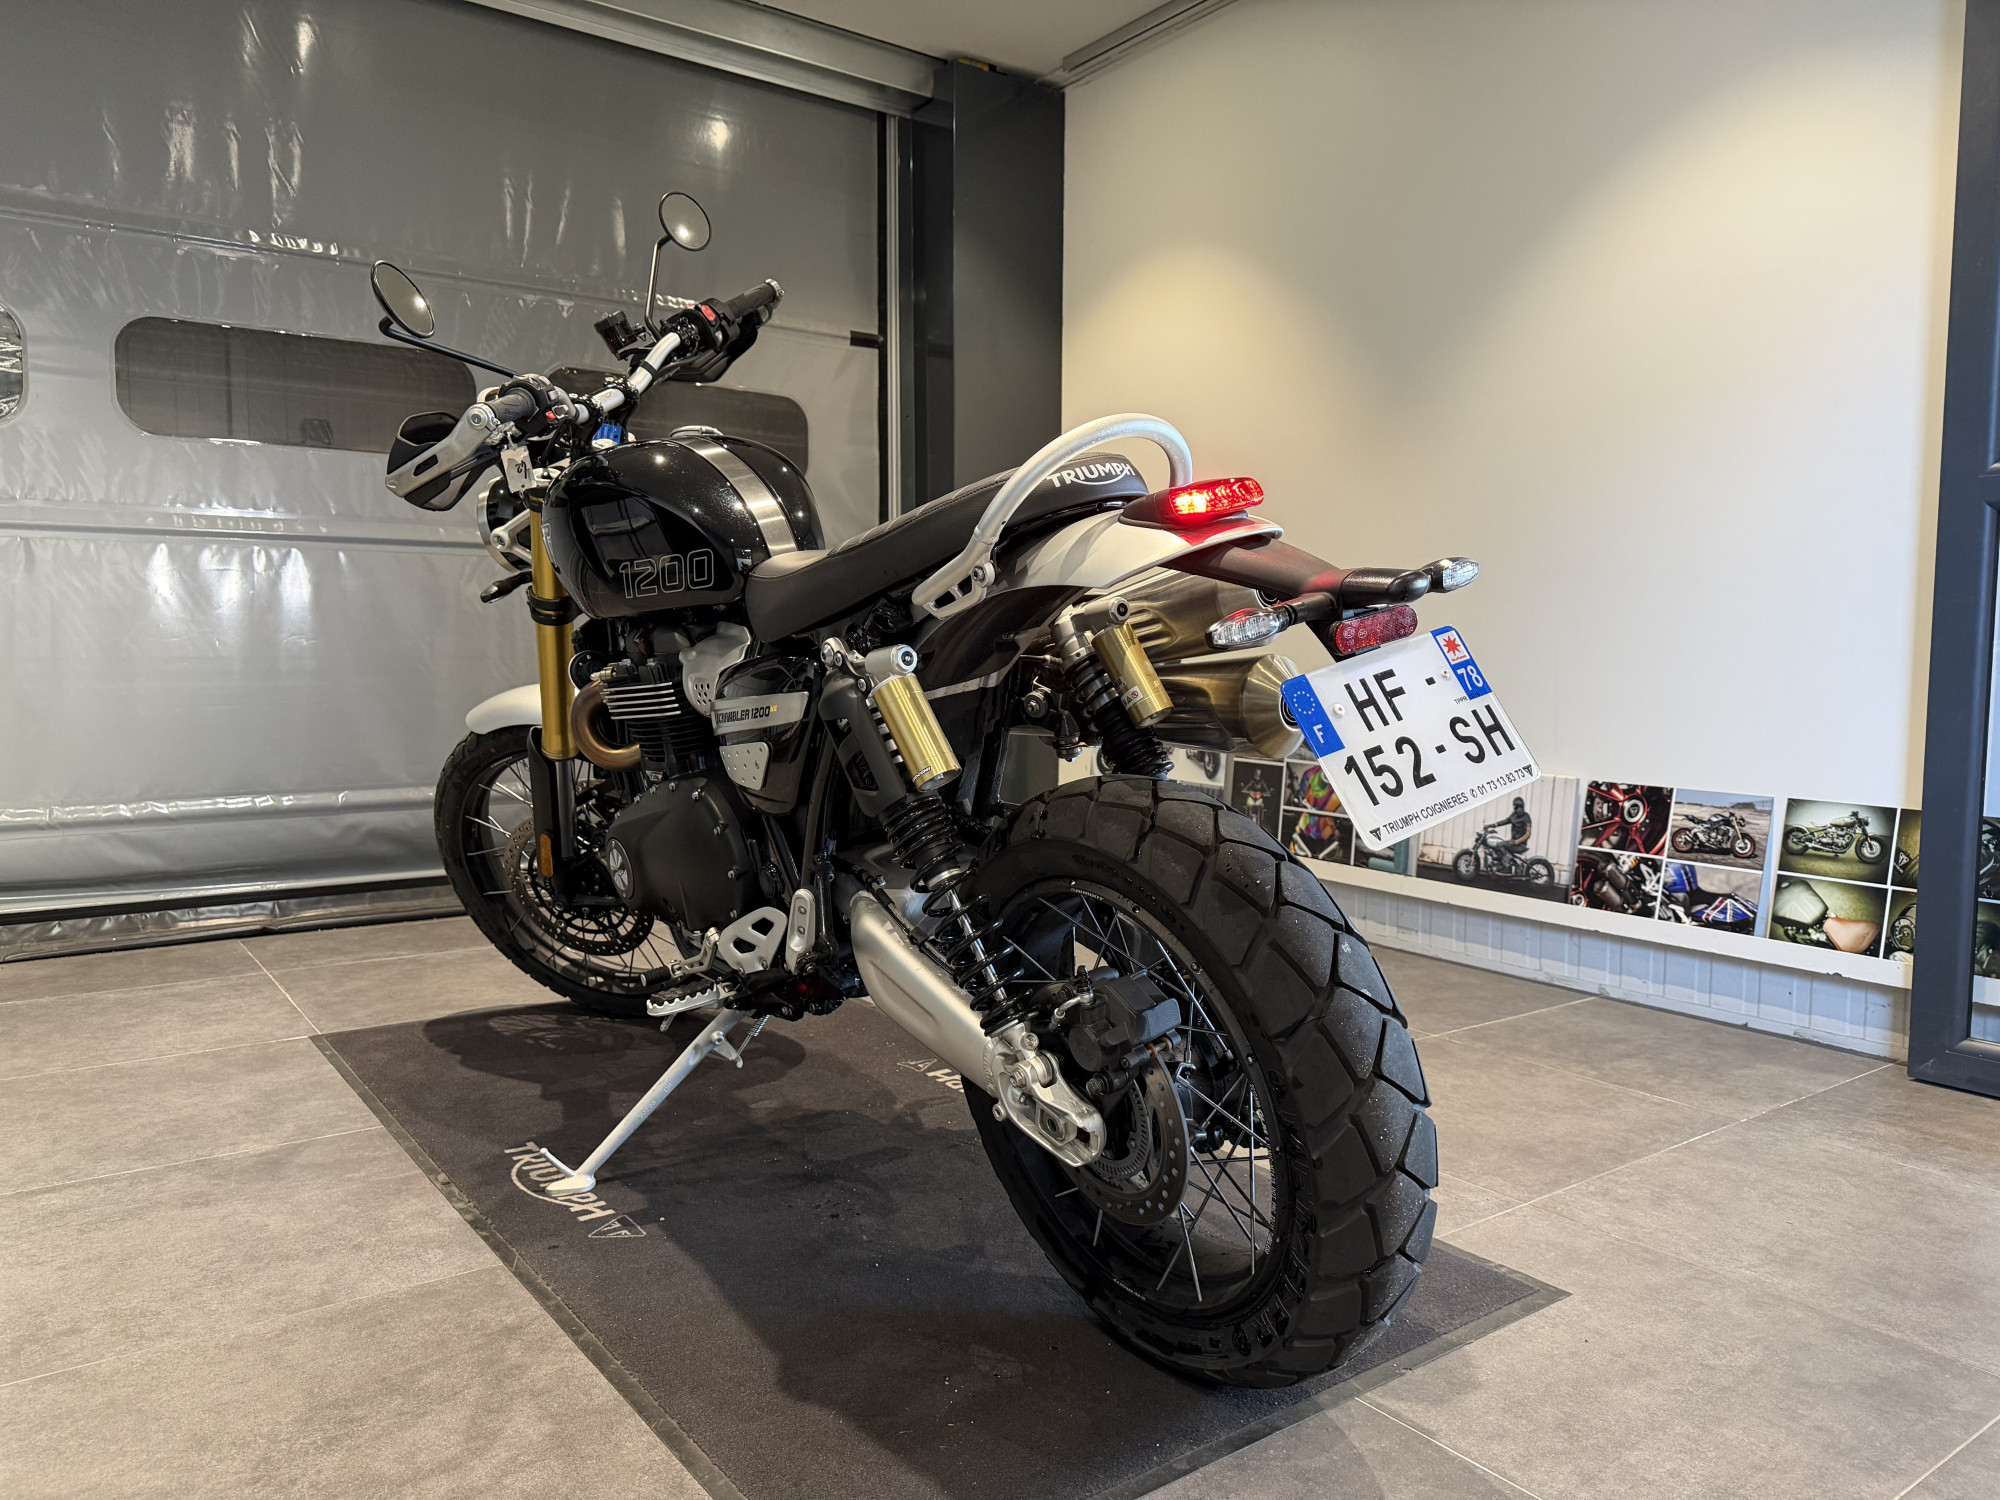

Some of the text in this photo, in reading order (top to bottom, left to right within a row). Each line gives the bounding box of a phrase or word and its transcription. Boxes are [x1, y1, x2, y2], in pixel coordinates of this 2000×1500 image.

[1047, 462, 1136, 487] TRIUMPH
[619, 548, 714, 598] 1200
[1456, 664, 1484, 691] 78
[751, 705, 771, 719] 1200
[1344, 668, 1406, 732] HF
[1313, 723, 1325, 744] F
[1383, 768, 1526, 835] TRIUMPH COIGNIERES 01 73 13 83 73
[504, 1142, 616, 1222] TRIUPH
